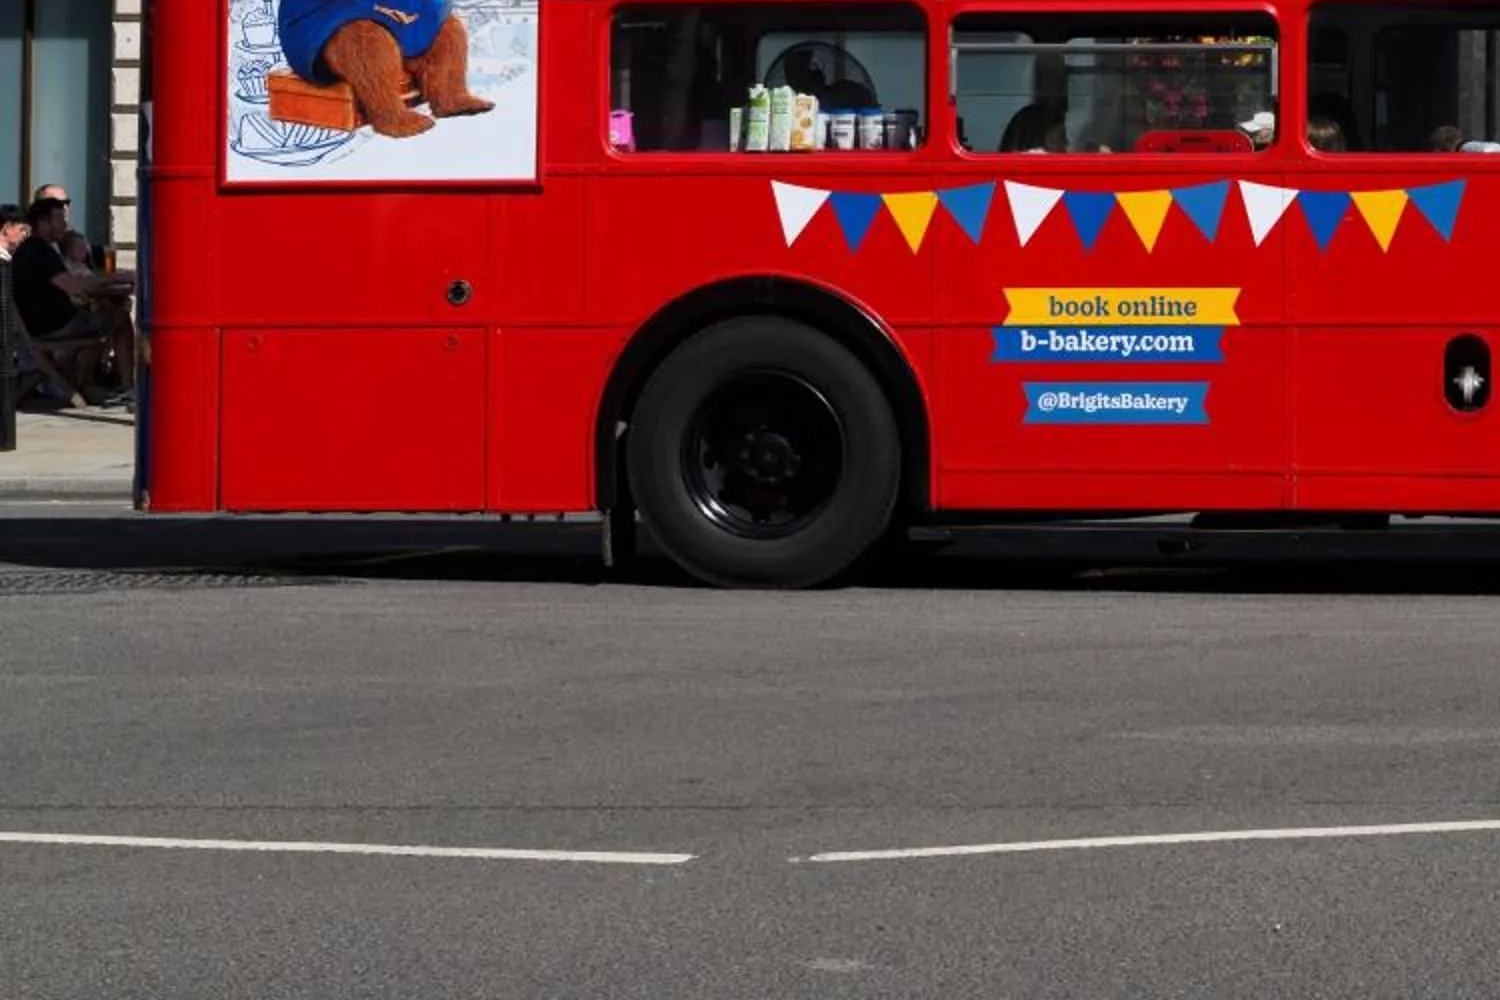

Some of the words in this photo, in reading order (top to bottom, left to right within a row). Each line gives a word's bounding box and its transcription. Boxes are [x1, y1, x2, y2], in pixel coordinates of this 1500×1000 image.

[1050, 295, 1111, 317] book
[1117, 295, 1198, 318] online
[1020, 329, 1194, 357] b-bakery.com
[1037, 391, 1188, 414] @BrigitsBakery
